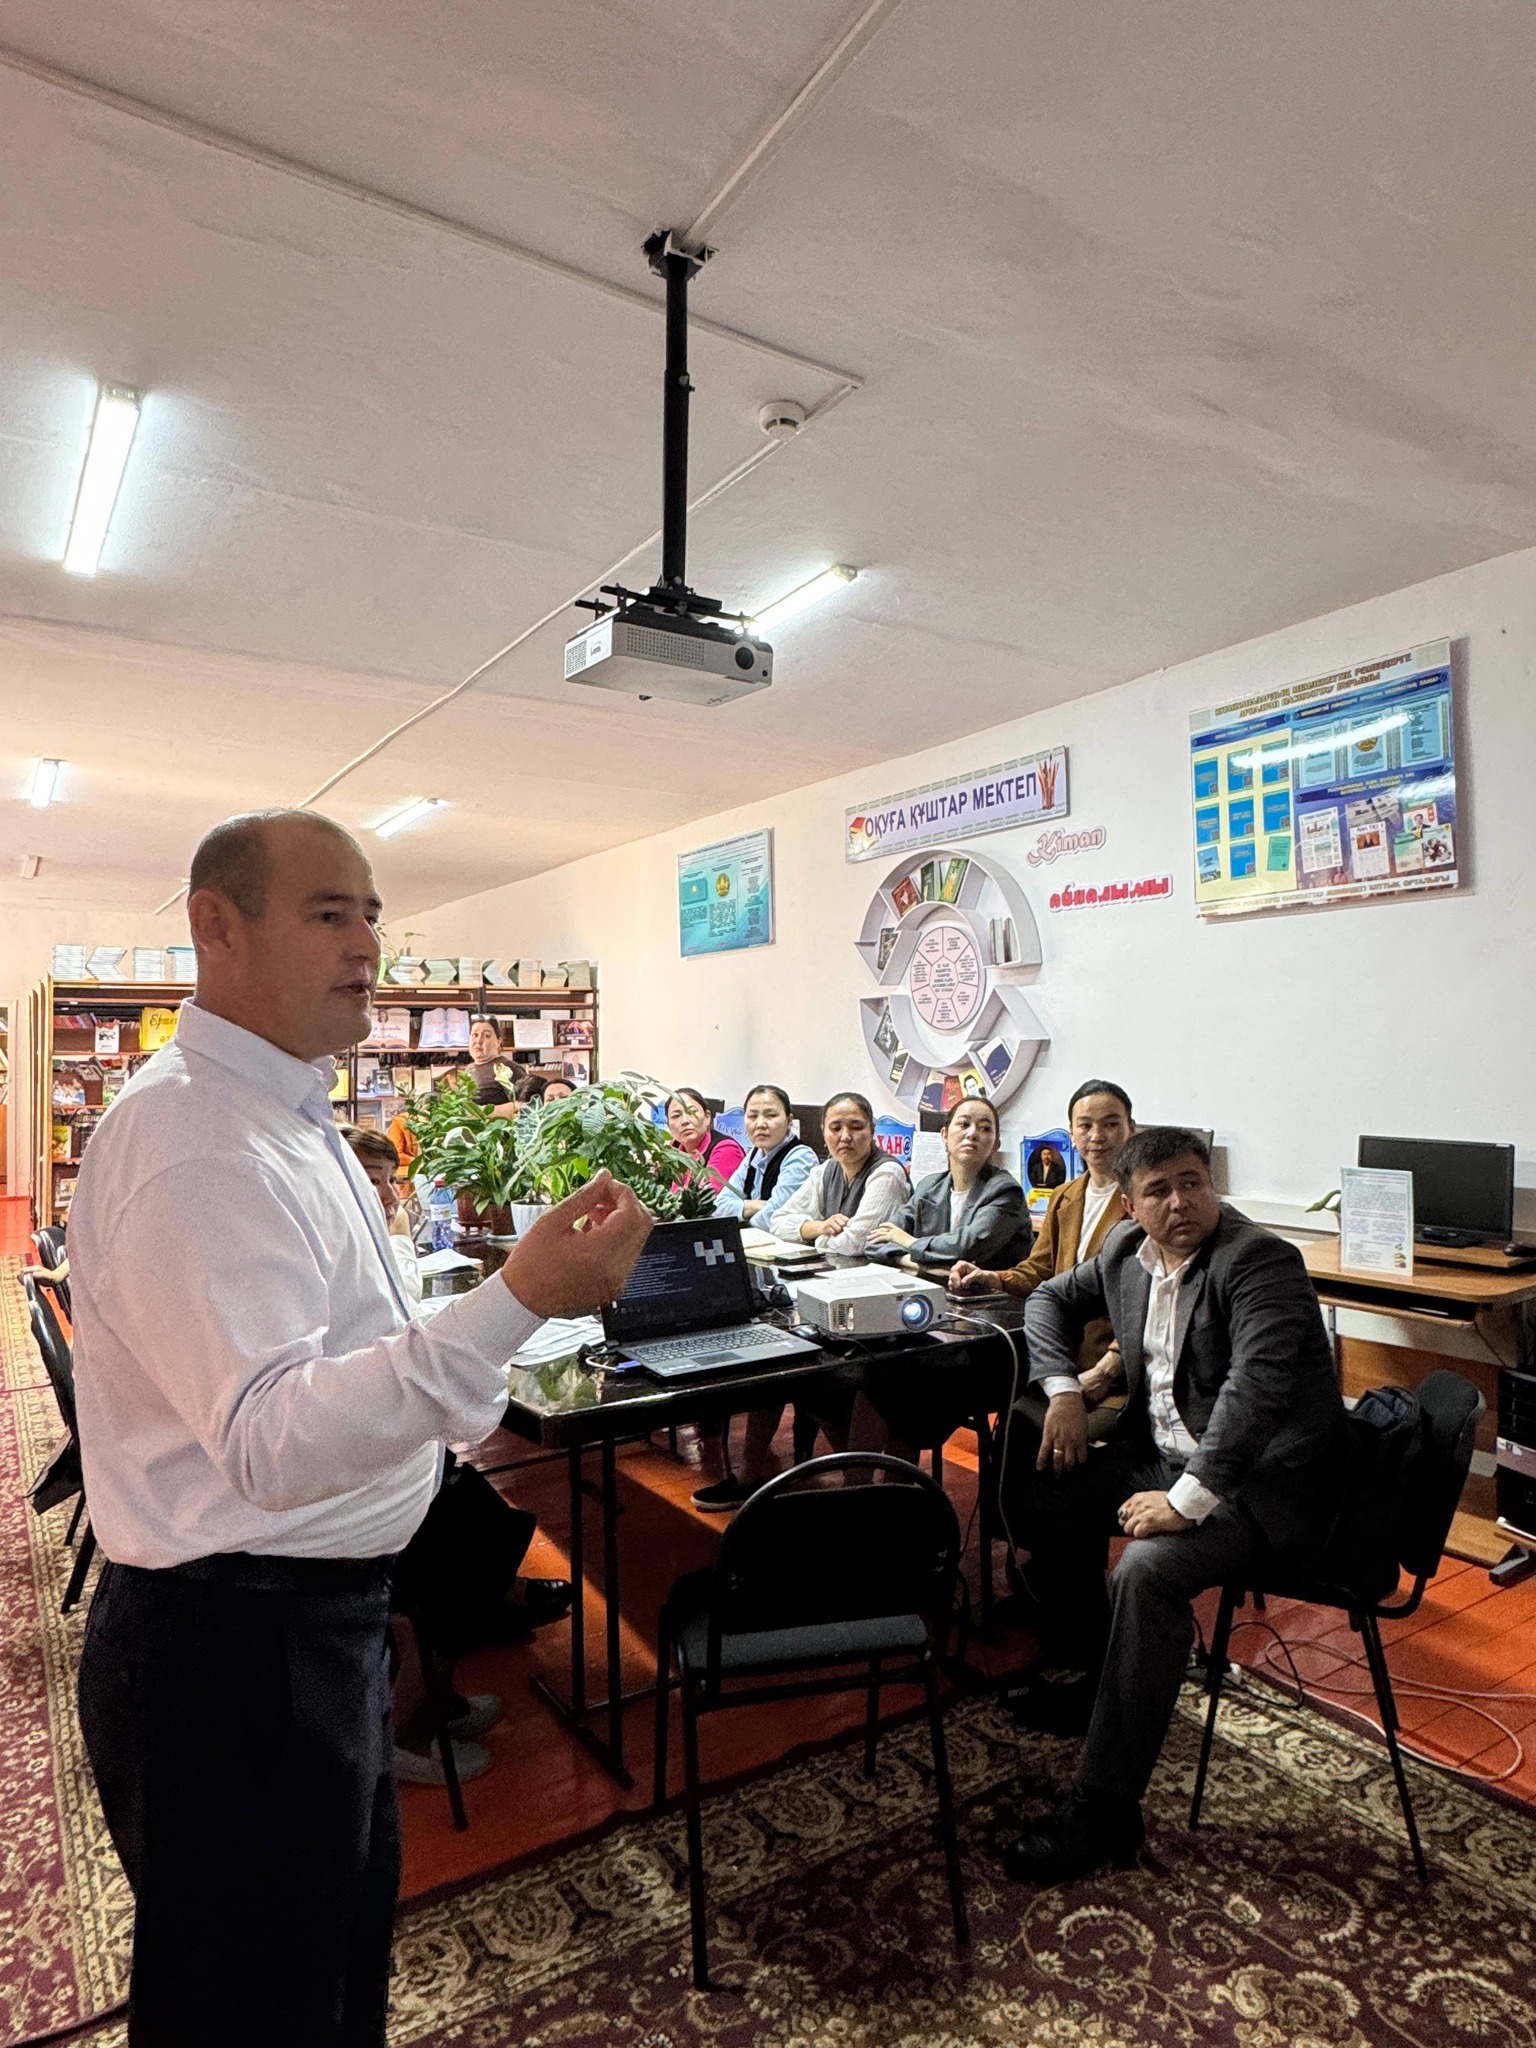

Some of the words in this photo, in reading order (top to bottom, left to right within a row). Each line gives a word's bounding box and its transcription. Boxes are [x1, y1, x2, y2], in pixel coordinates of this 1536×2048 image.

[865, 809, 906, 839] ОҚУҒА
[910, 791, 968, 830] ҚҰШТАР
[972, 772, 1037, 811] МЕКТЕП
[1027, 828, 1104, 865] Кітап
